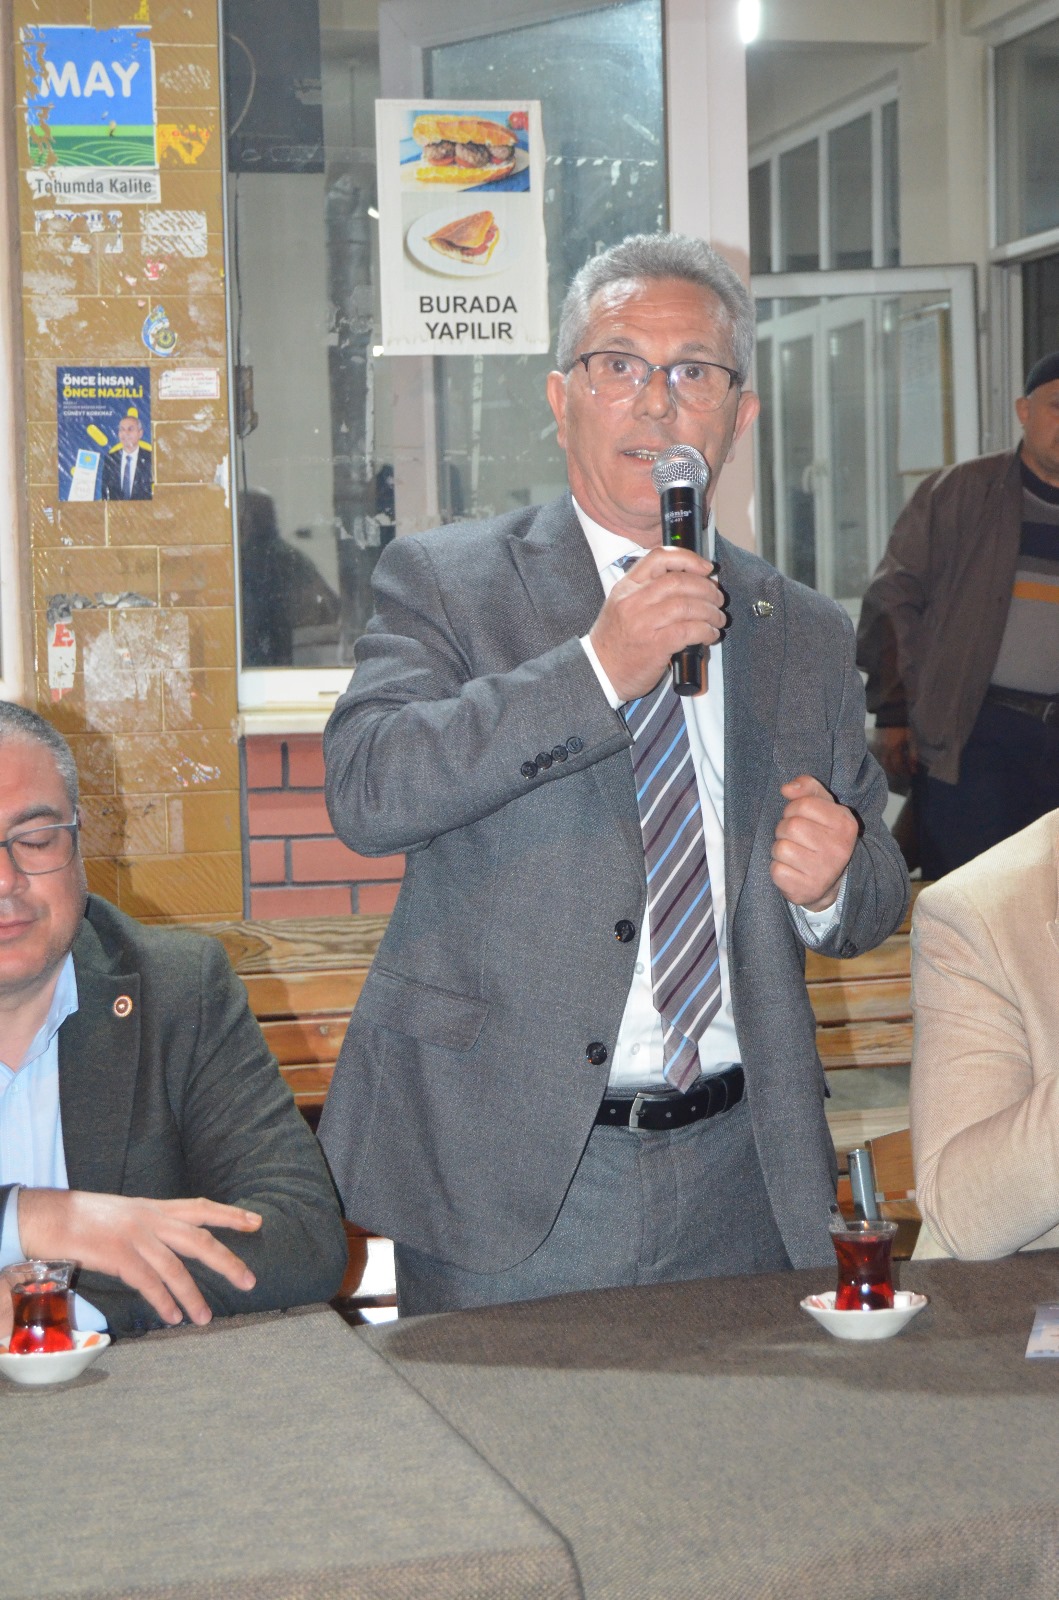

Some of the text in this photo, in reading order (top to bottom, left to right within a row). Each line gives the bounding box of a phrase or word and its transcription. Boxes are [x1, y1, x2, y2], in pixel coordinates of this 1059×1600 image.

[39, 61, 140, 98] MAY
[35, 178, 152, 194] Tohumda Kalite
[420, 296, 517, 313] BURADA
[425, 322, 514, 340] YAPILIR
[63, 373, 134, 386] ÖNCE İNSAN
[63, 385, 143, 398] ÖNCE NAZİLLİ
